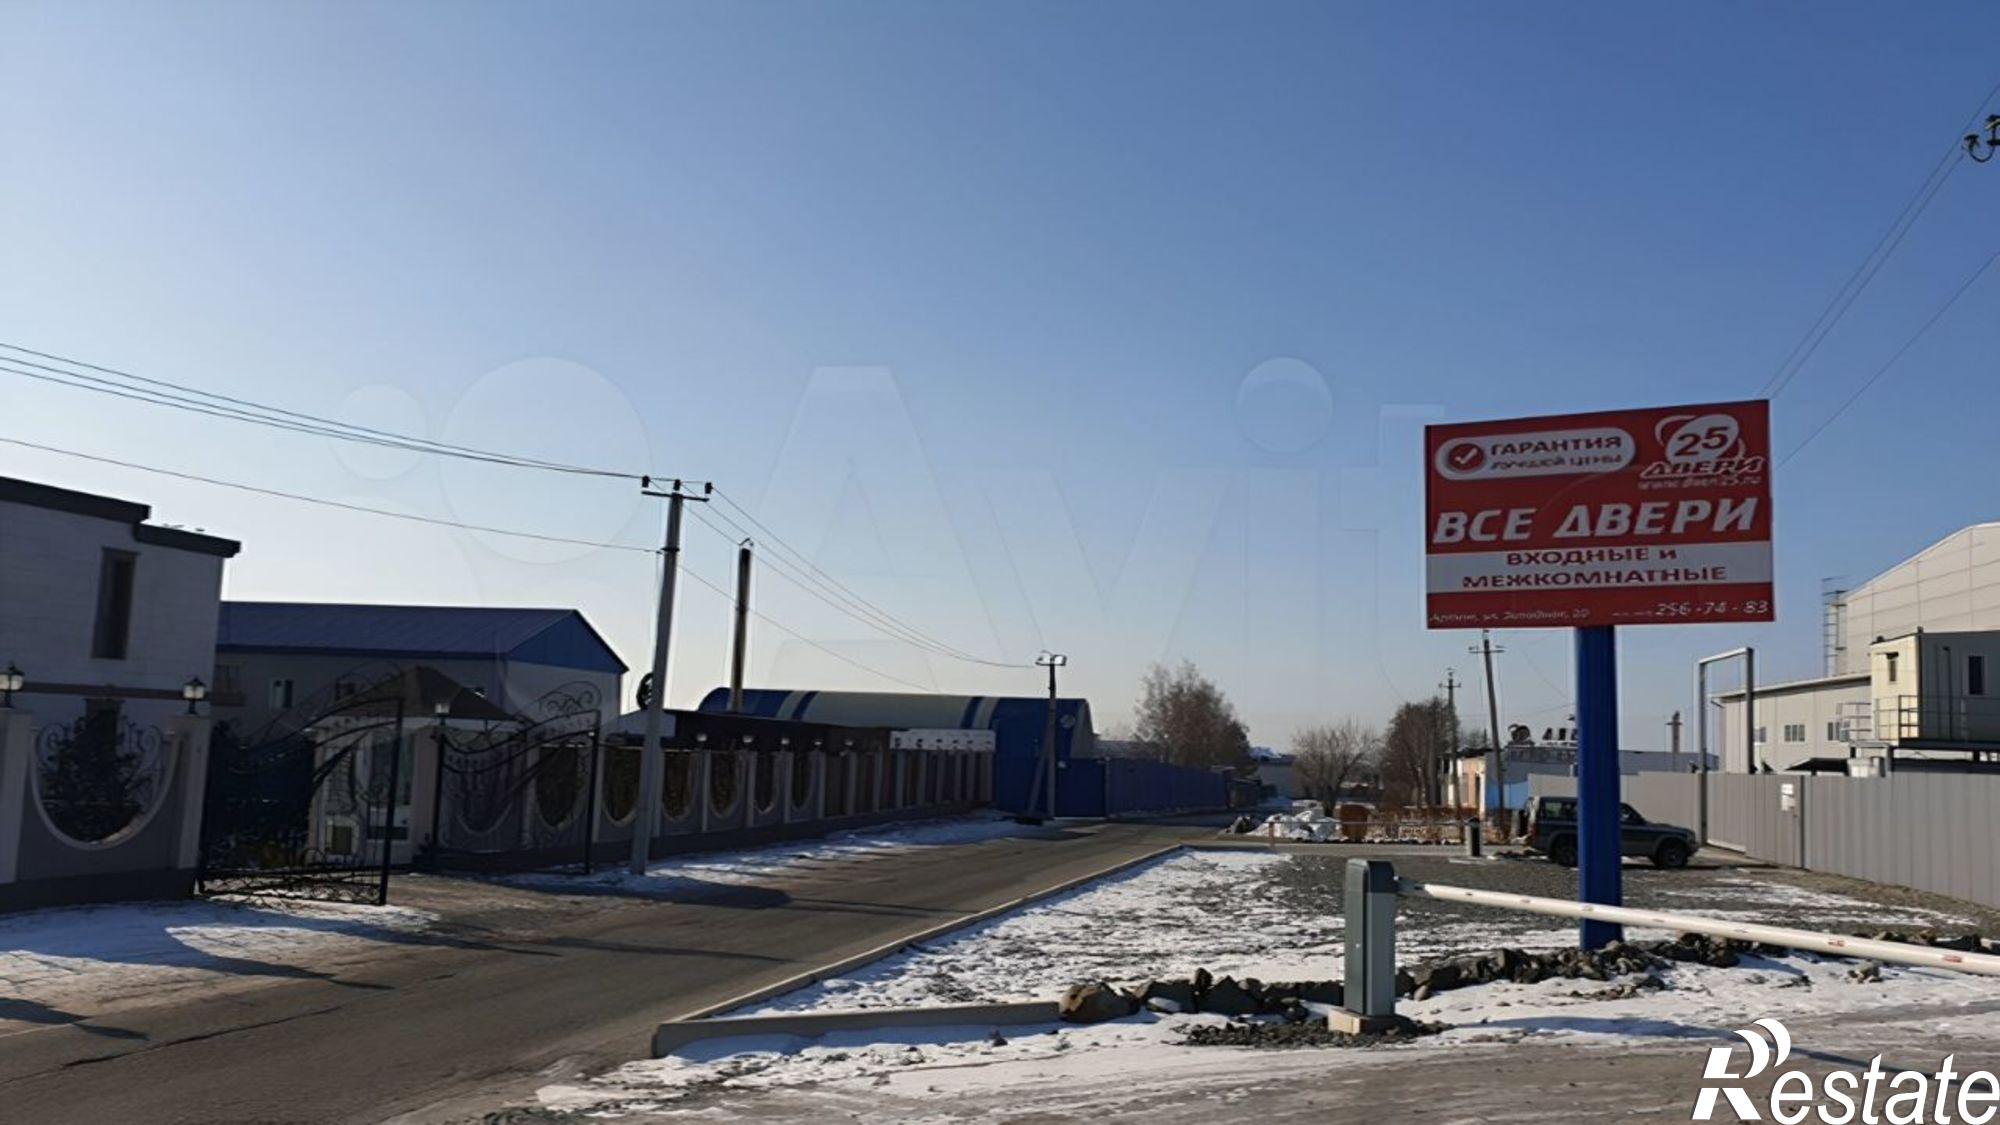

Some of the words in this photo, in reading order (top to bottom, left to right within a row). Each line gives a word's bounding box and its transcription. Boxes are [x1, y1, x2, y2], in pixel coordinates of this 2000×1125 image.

[1491, 436, 1622, 455] ГАРАНТИЯ
[1674, 426, 1730, 457] 25
[1432, 508, 1537, 544] ВСЕ
[1552, 498, 1758, 538] ДВЕРИ
[1507, 547, 1649, 566] ВХОДНЫЕ
[1462, 567, 1727, 588] МЕЖКОМНАТНЫЕ
